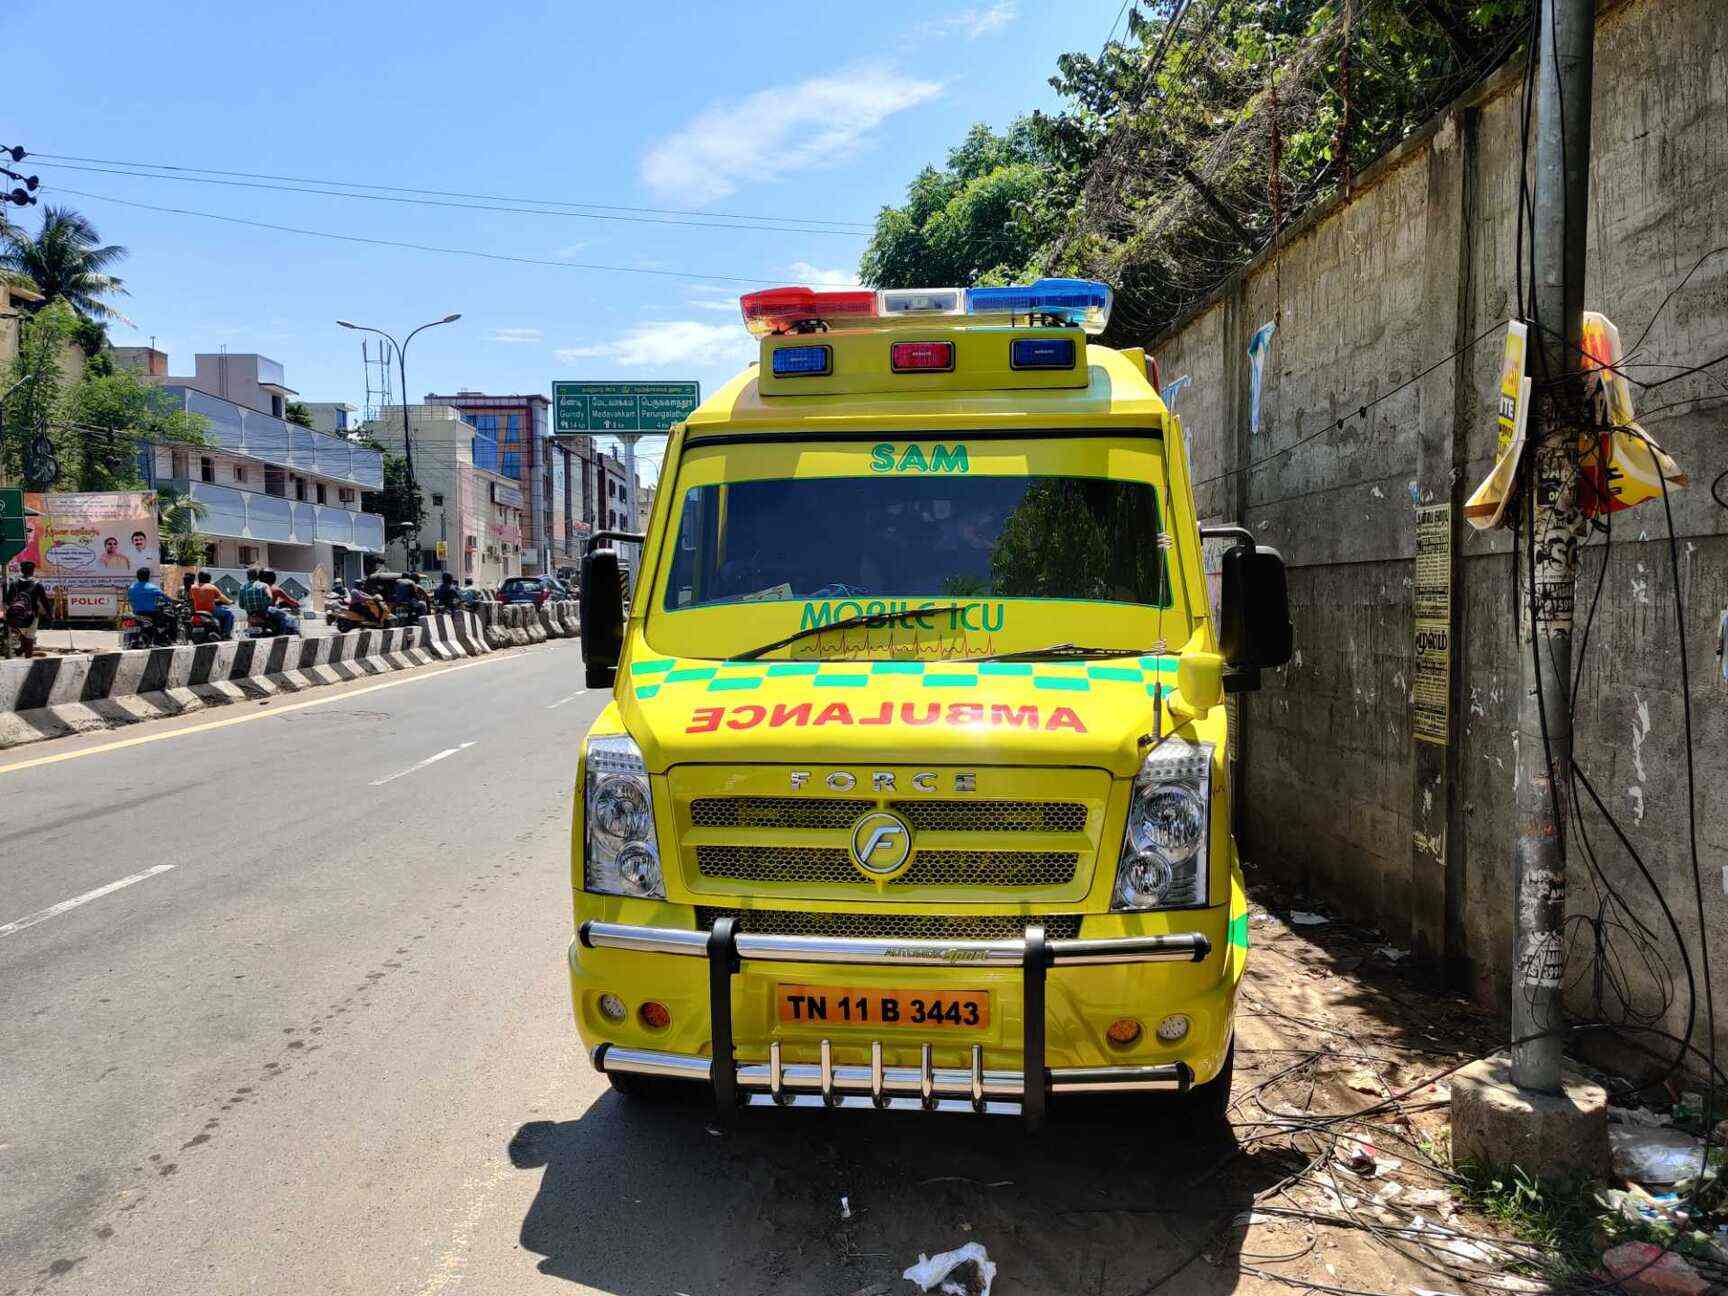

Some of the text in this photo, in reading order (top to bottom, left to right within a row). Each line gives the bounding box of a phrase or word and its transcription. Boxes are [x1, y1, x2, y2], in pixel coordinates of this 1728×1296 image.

[870, 443, 969, 472] SAM
[71, 597, 109, 605] POLIC
[800, 601, 1004, 632] MOBILE ICU
[790, 770, 977, 792] FORCE
[787, 995, 980, 1026] TN 11 B 3443
